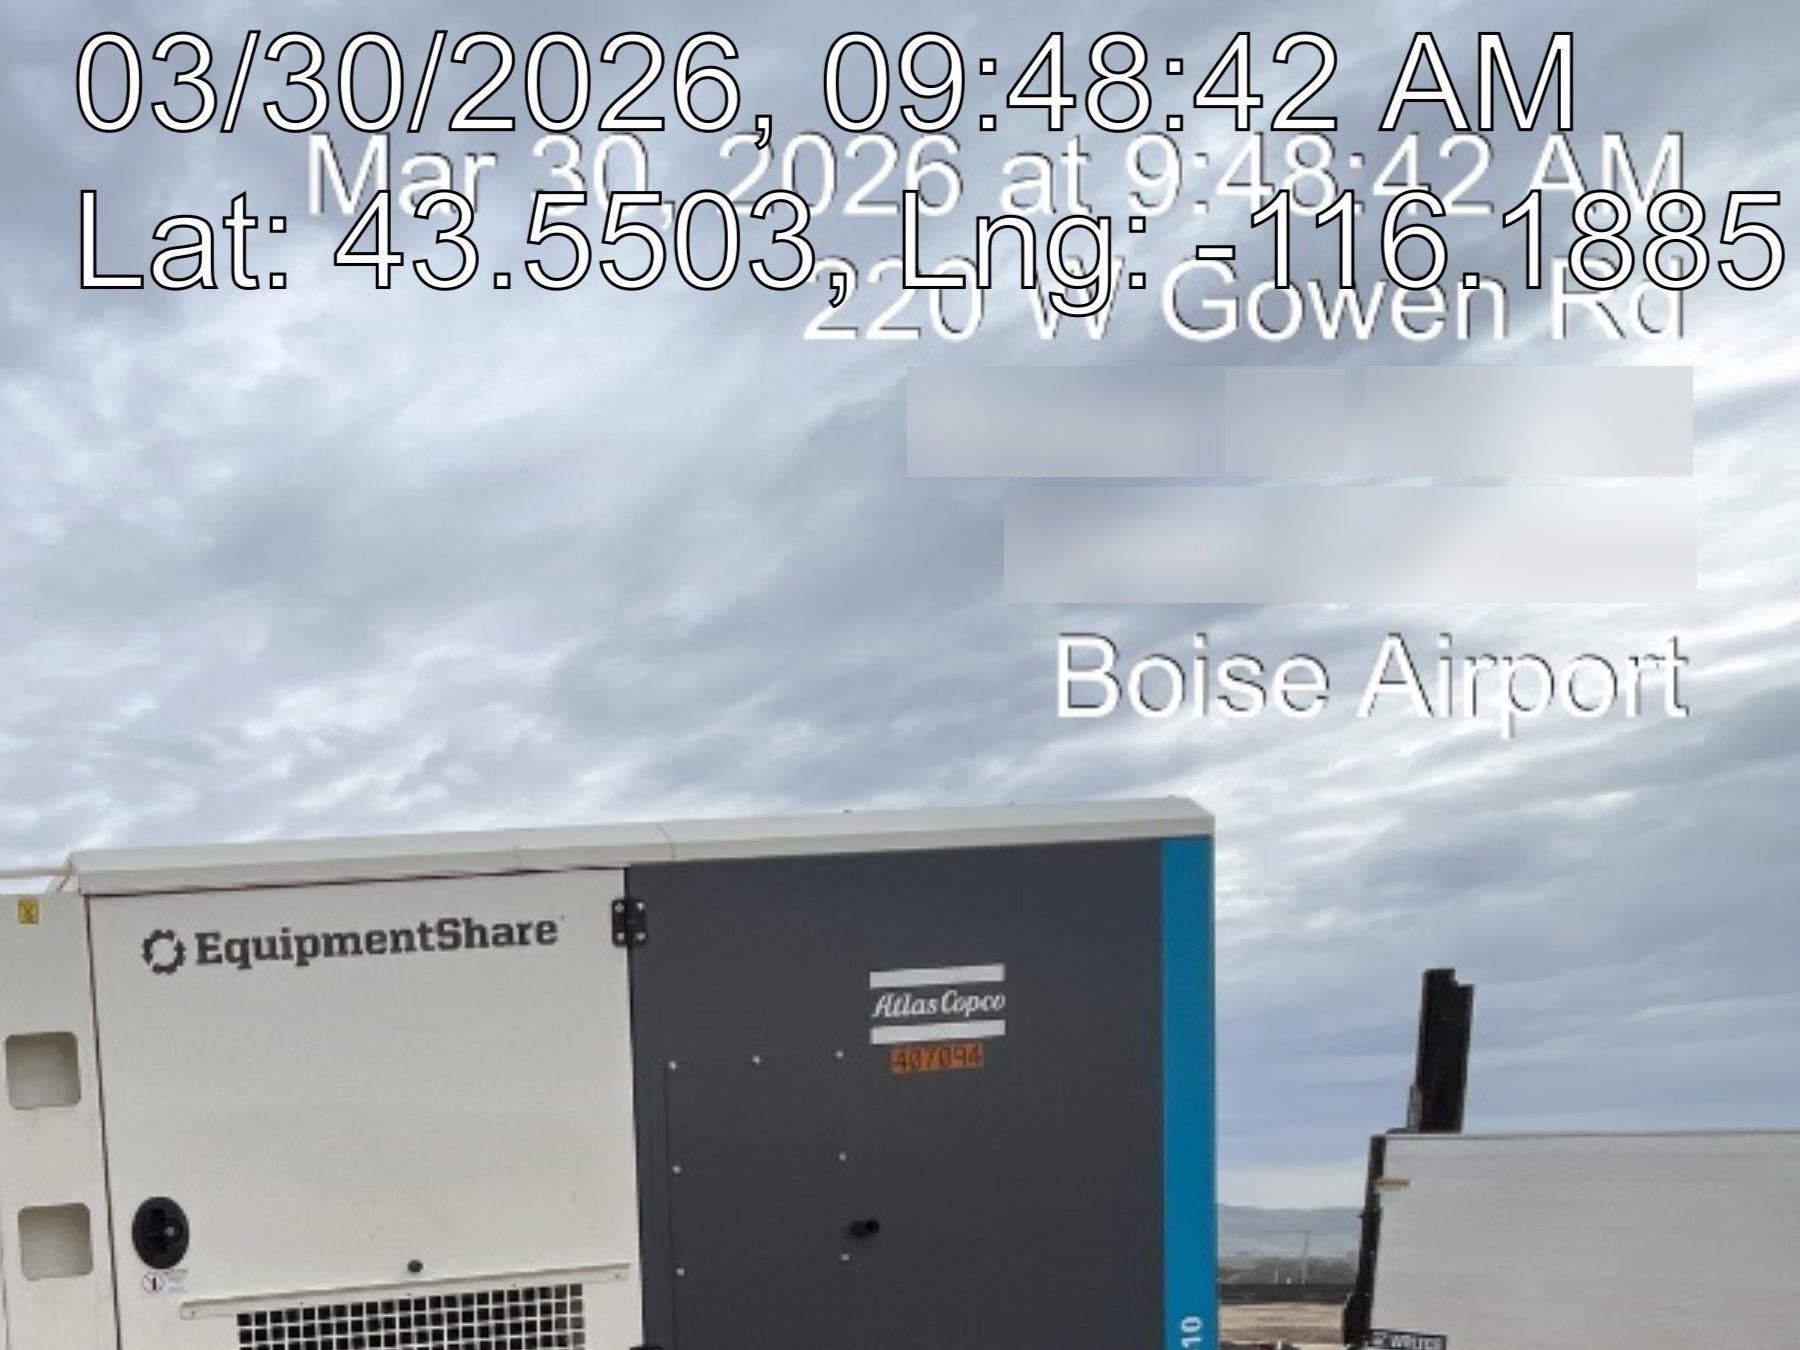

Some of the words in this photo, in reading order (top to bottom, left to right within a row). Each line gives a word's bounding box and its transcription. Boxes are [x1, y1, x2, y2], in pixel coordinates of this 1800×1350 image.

[194, 916, 559, 970] EquipmentShare
[870, 991, 938, 1019] Atlas
[941, 989, 1007, 1018] Copco
